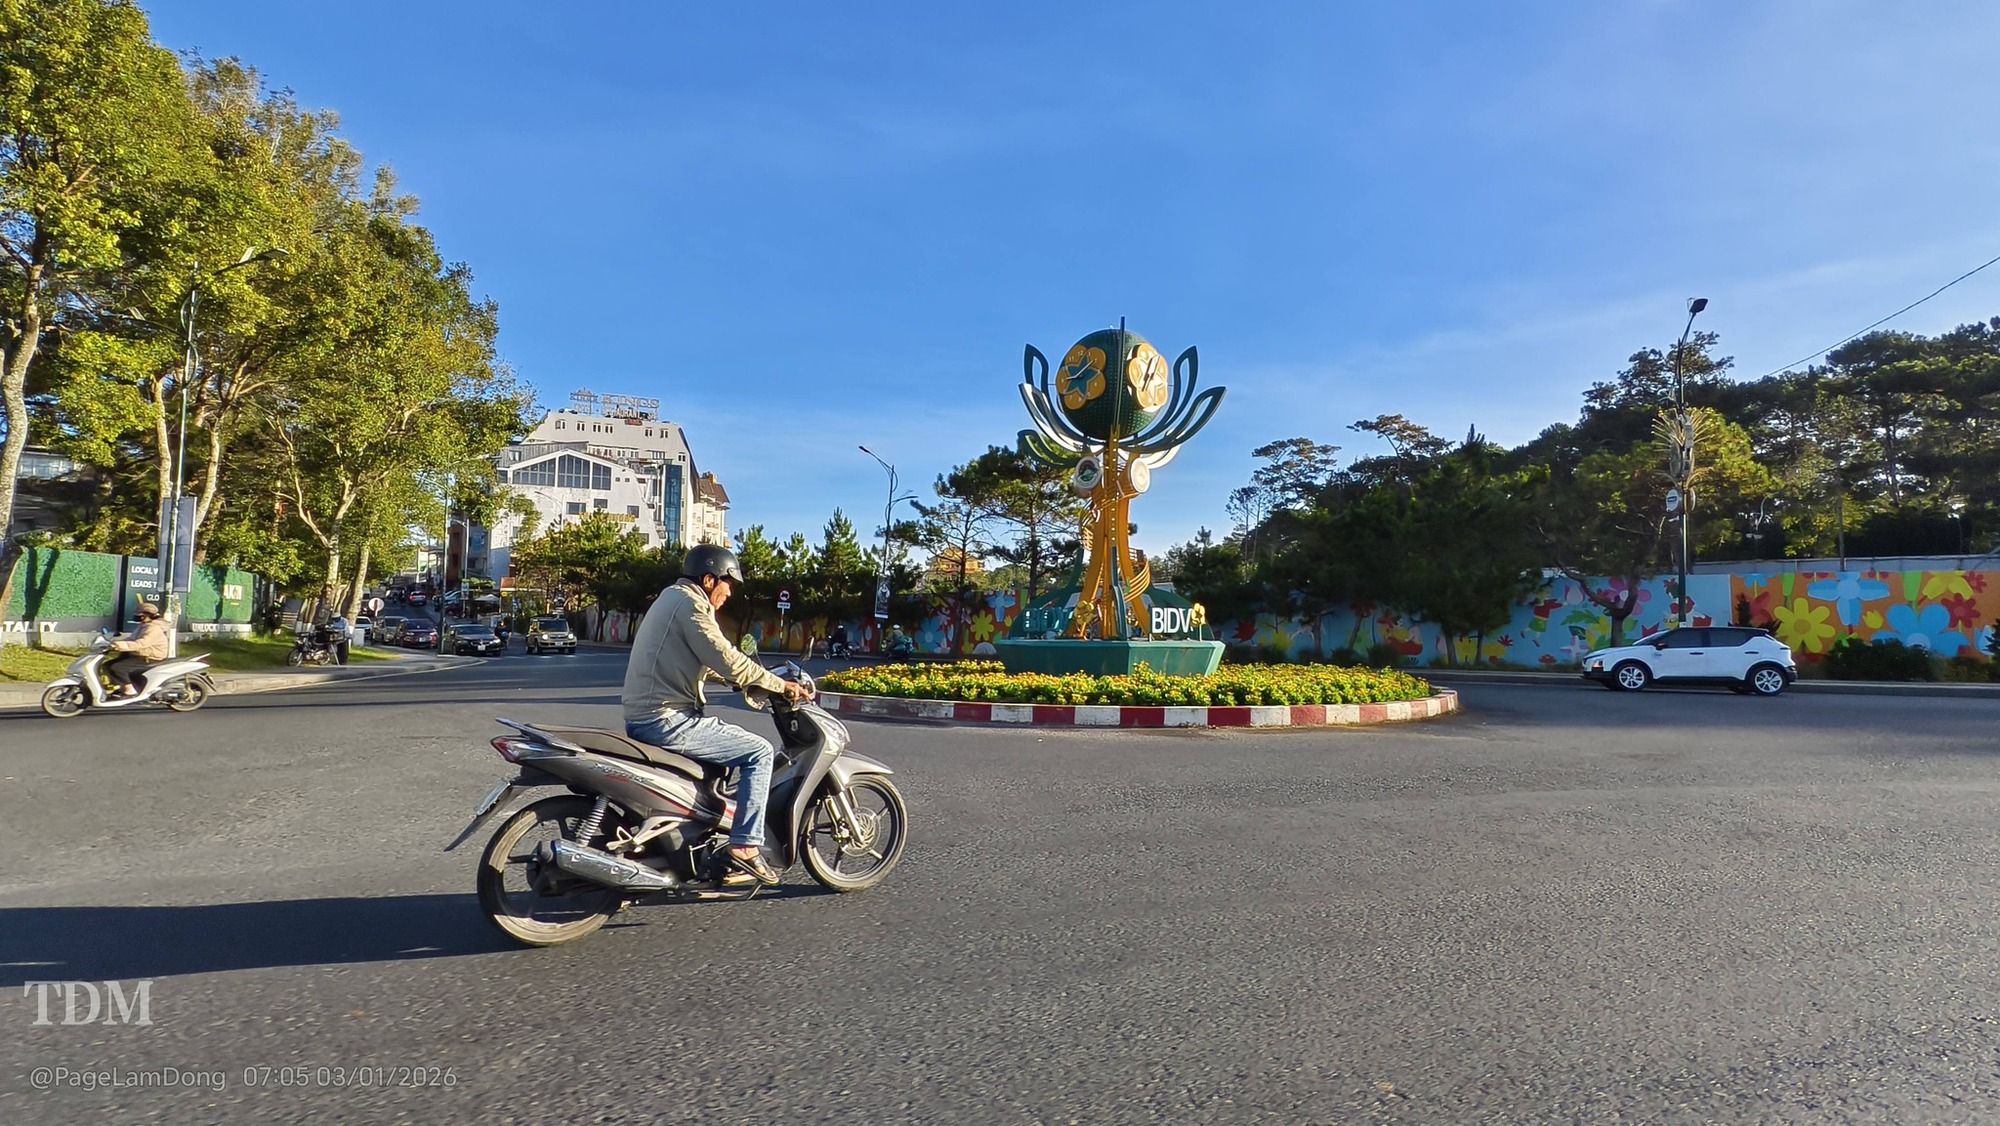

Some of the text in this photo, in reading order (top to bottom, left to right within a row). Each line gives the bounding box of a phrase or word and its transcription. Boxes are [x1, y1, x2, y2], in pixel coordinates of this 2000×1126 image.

[131, 565, 153, 575] LOCAL
[130, 579, 152, 588] LEADS
[1151, 607, 1193, 633] BIDV
